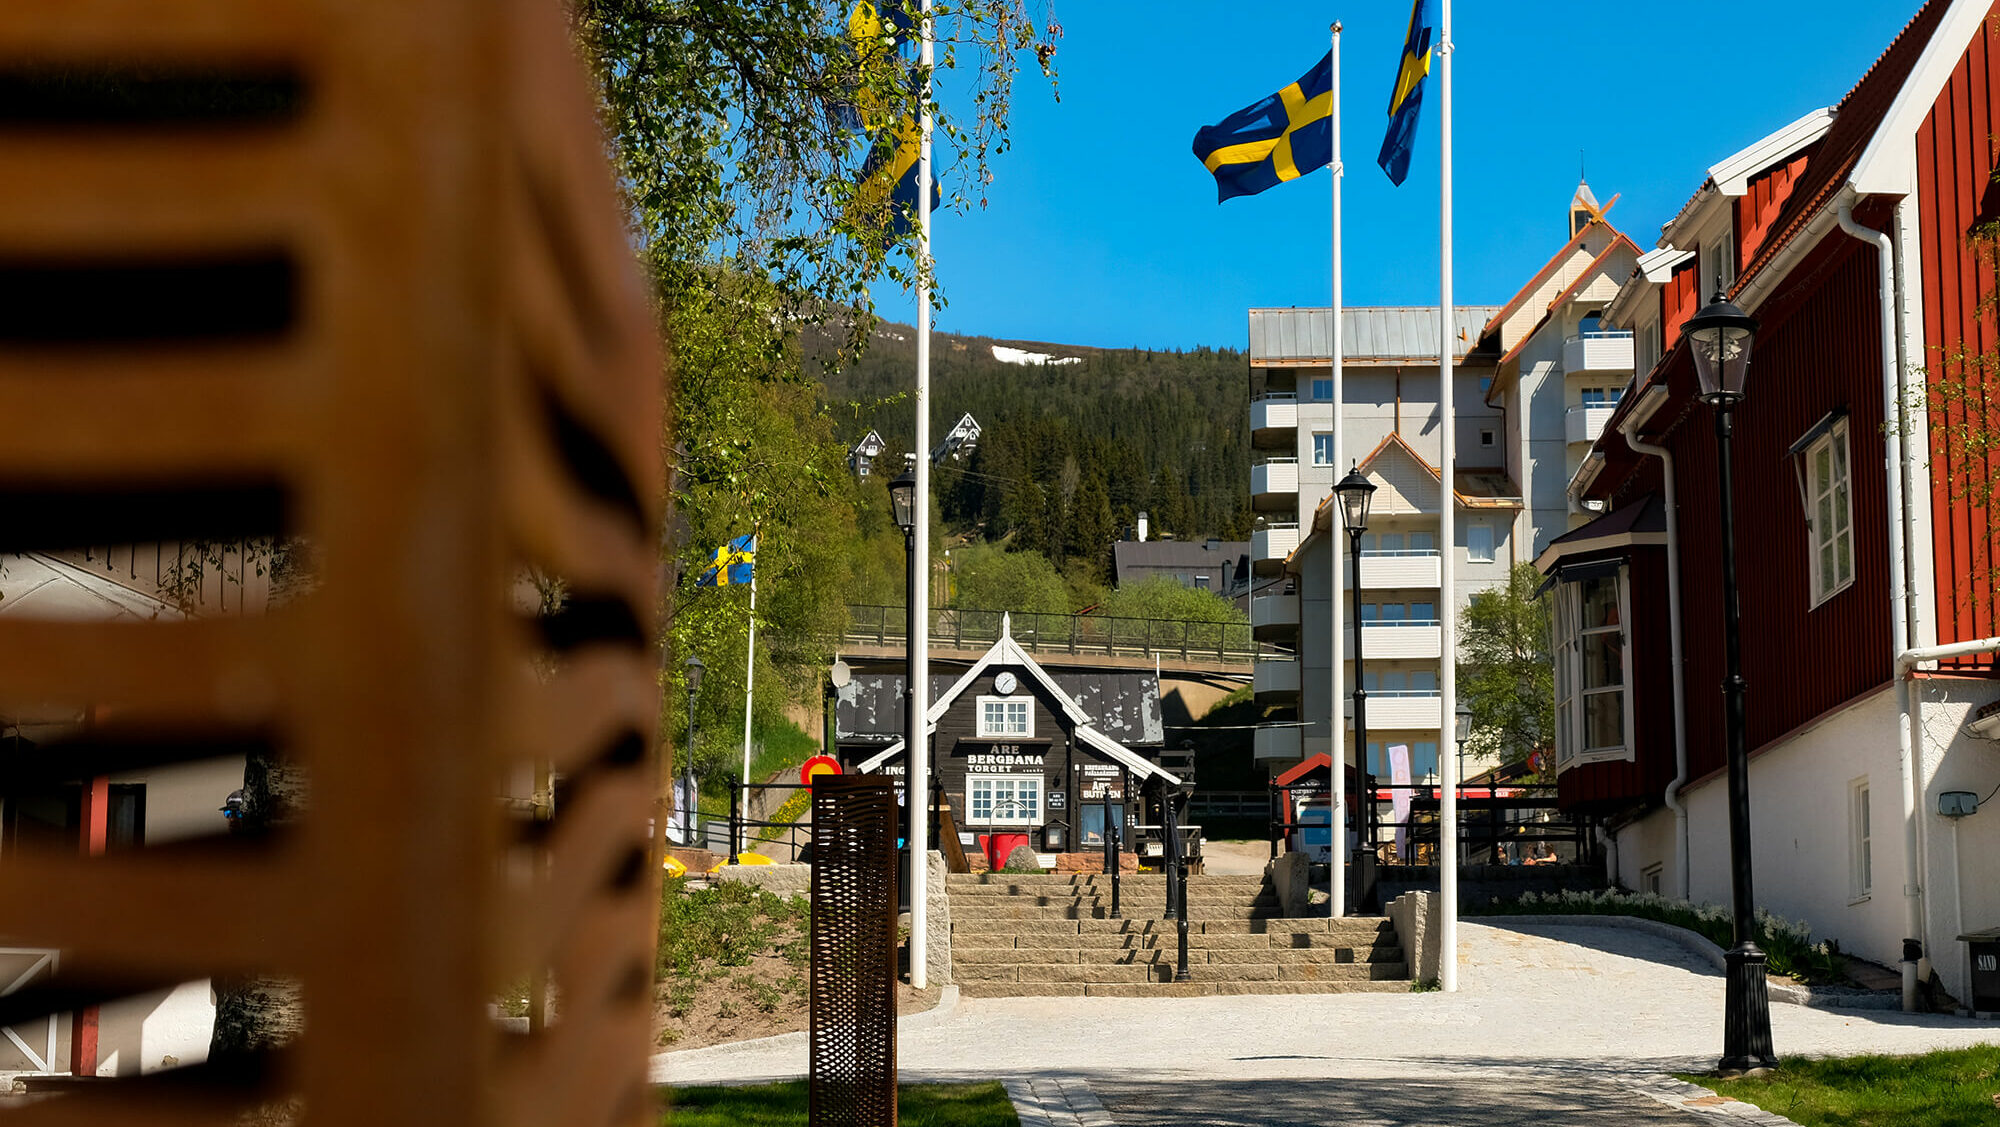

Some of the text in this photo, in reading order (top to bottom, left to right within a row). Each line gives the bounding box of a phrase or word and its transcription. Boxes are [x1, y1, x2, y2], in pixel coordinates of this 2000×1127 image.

[967, 754, 1044, 765] BERGBANA
[967, 764, 1012, 772] TORGET
[1083, 790, 1121, 798] BUTIEN
[1978, 954, 1996, 971] SAND
